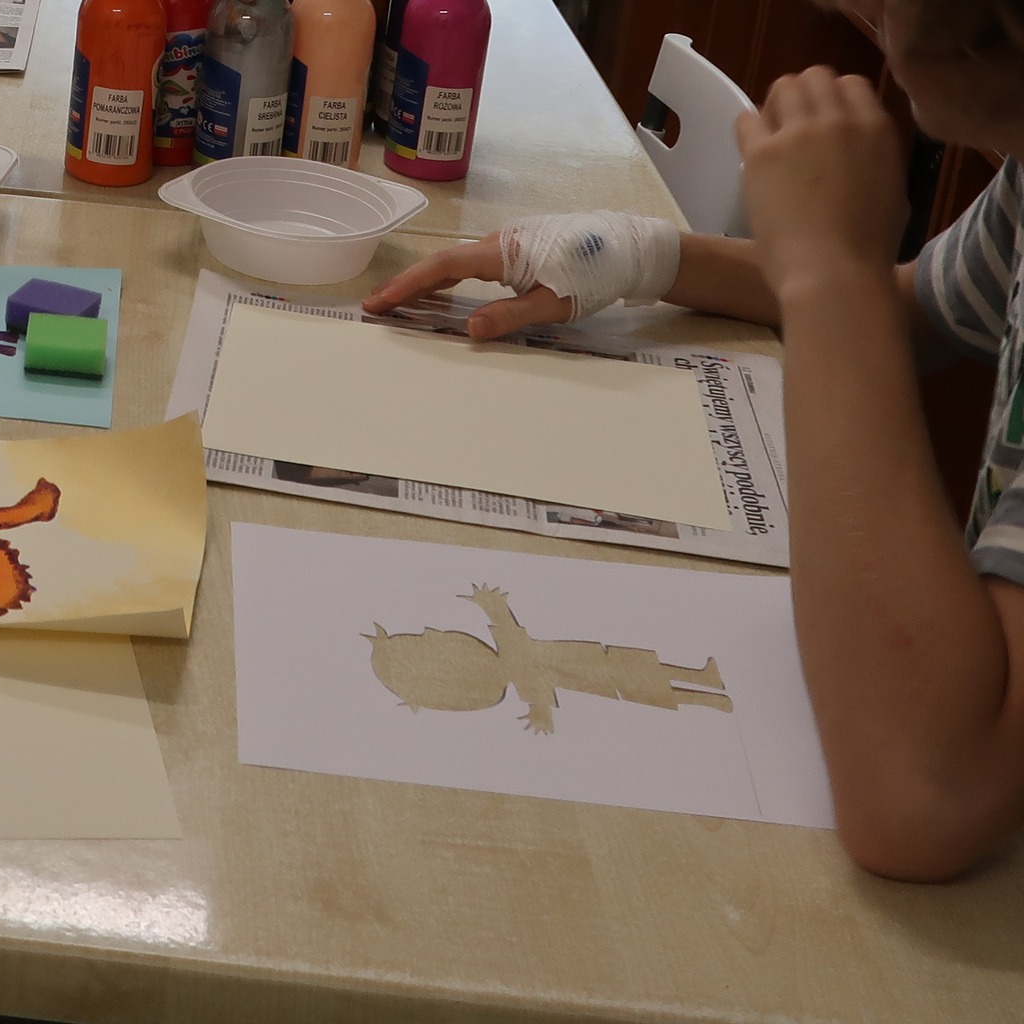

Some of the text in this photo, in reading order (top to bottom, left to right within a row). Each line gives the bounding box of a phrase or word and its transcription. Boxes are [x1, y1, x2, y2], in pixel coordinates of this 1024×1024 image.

[107, 93, 128, 103] FARBA
[437, 91, 461, 100] FARBA
[263, 99, 282, 109] FARBA
[323, 100, 346, 110] FARBA
[318, 111, 348, 121] CIELISTA
[697, 361, 776, 536] Świętujemy wszyscy podobnie,
